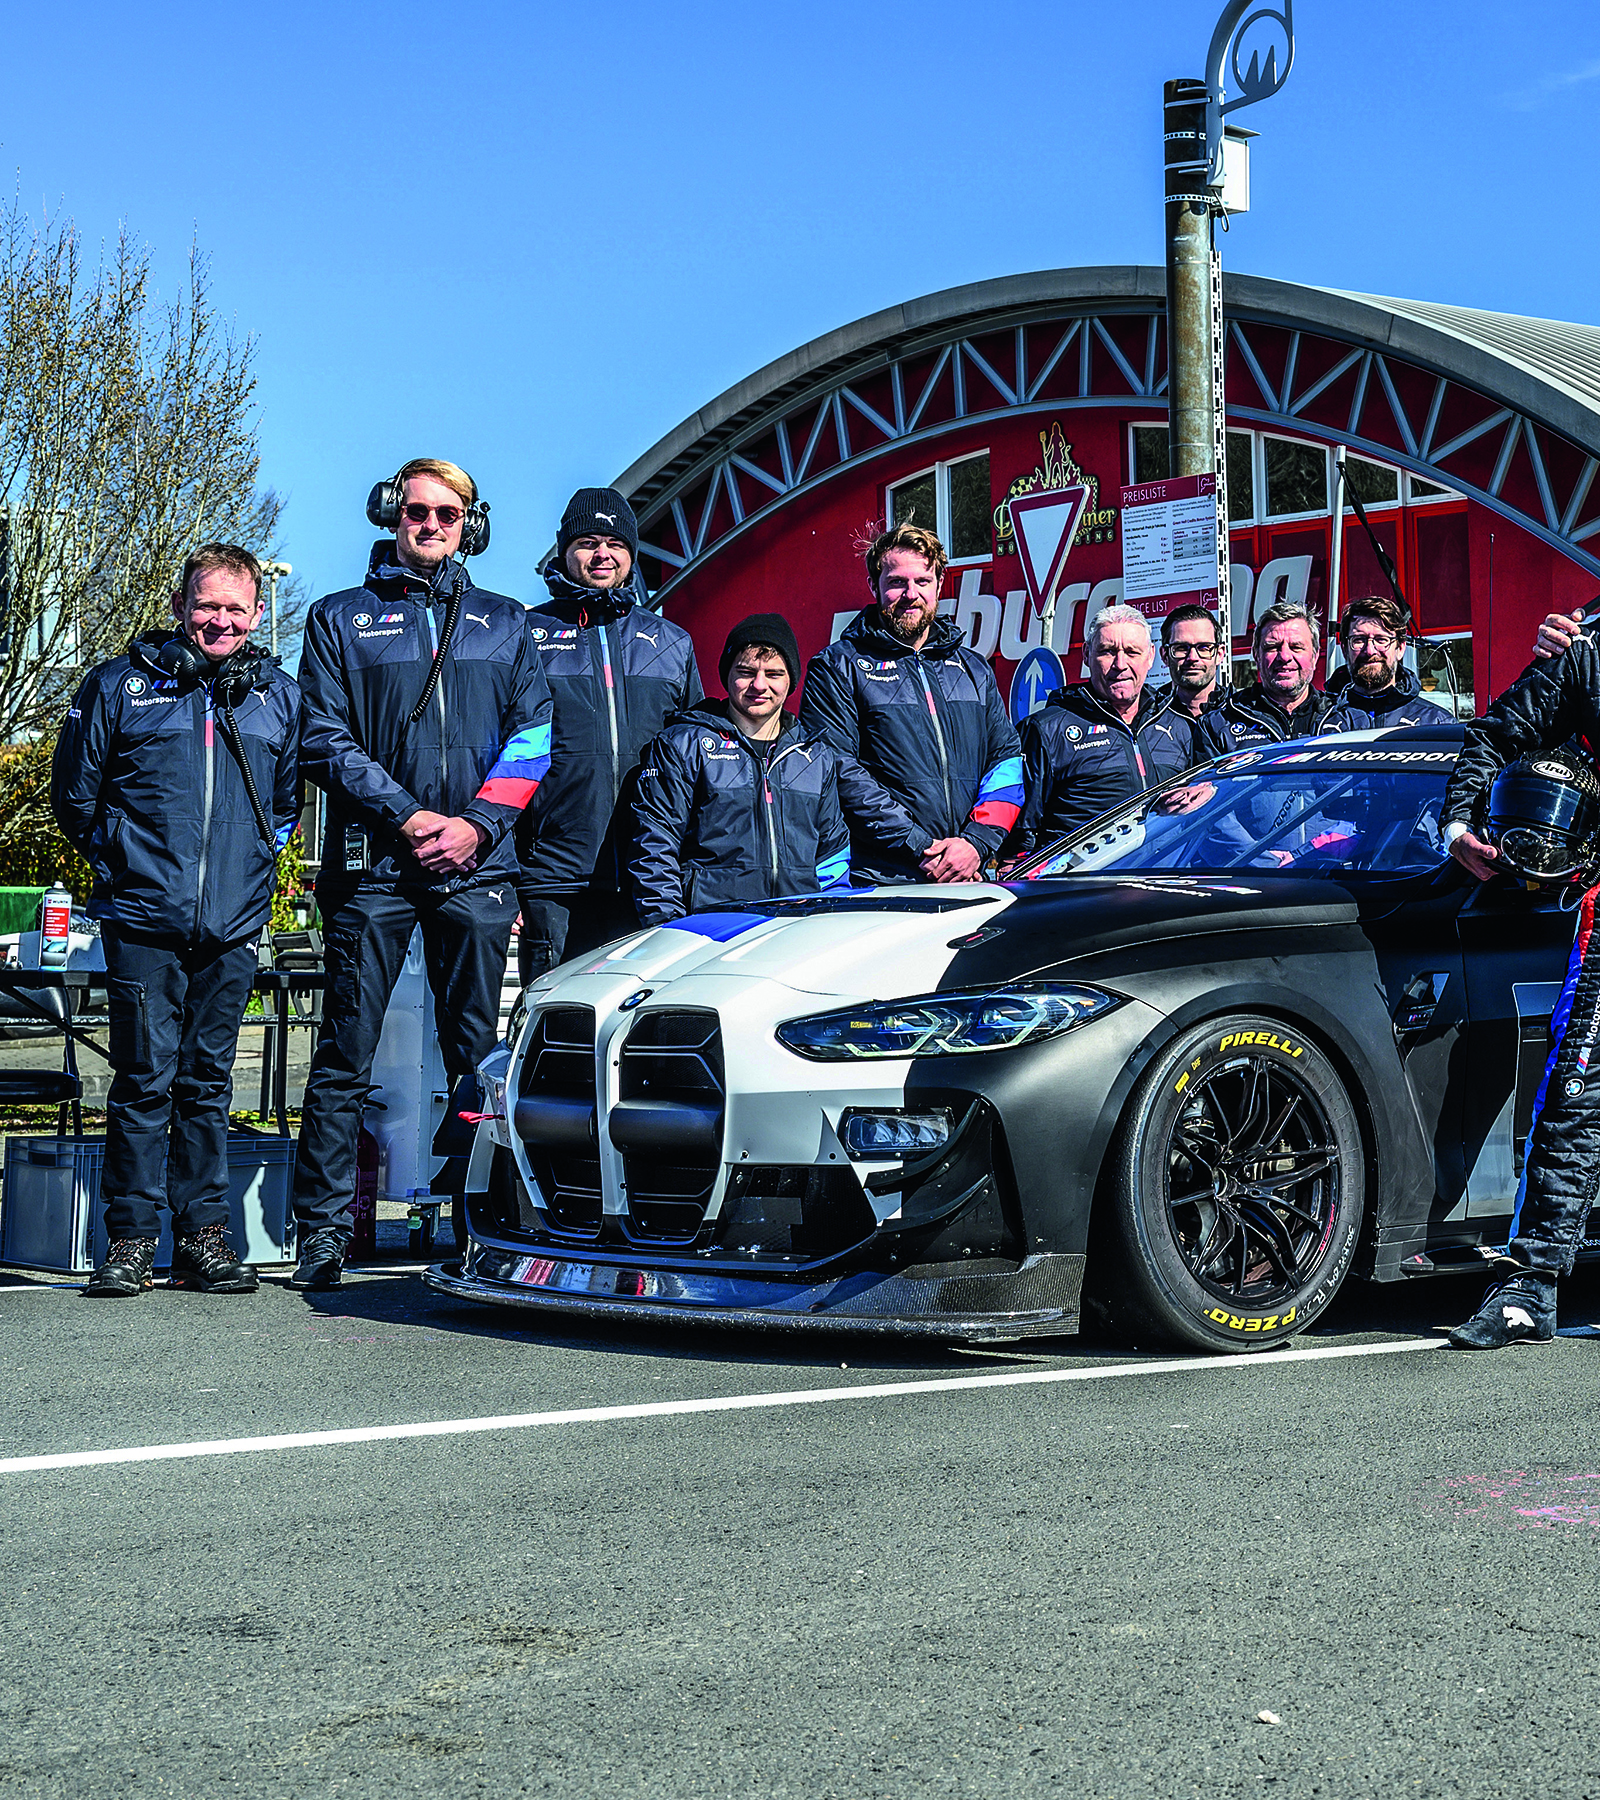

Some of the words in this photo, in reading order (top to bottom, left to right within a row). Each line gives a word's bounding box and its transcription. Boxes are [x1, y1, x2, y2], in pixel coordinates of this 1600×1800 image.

[1123, 485, 1167, 503] PREISLISTE
[1151, 600, 1168, 613] LIST
[358, 627, 403, 639] Motorsport
[131, 696, 178, 707] Motorsport
[1073, 738, 1111, 751] Motorsport
[706, 752, 740, 761] Motorsport
[1317, 749, 1460, 763] Motorspor
[1542, 762, 1569, 776] Arai
[1219, 1031, 1304, 1058] PIRELLI
[1209, 1307, 1280, 1332] ZERO
[1281, 1306, 1296, 1326] P
